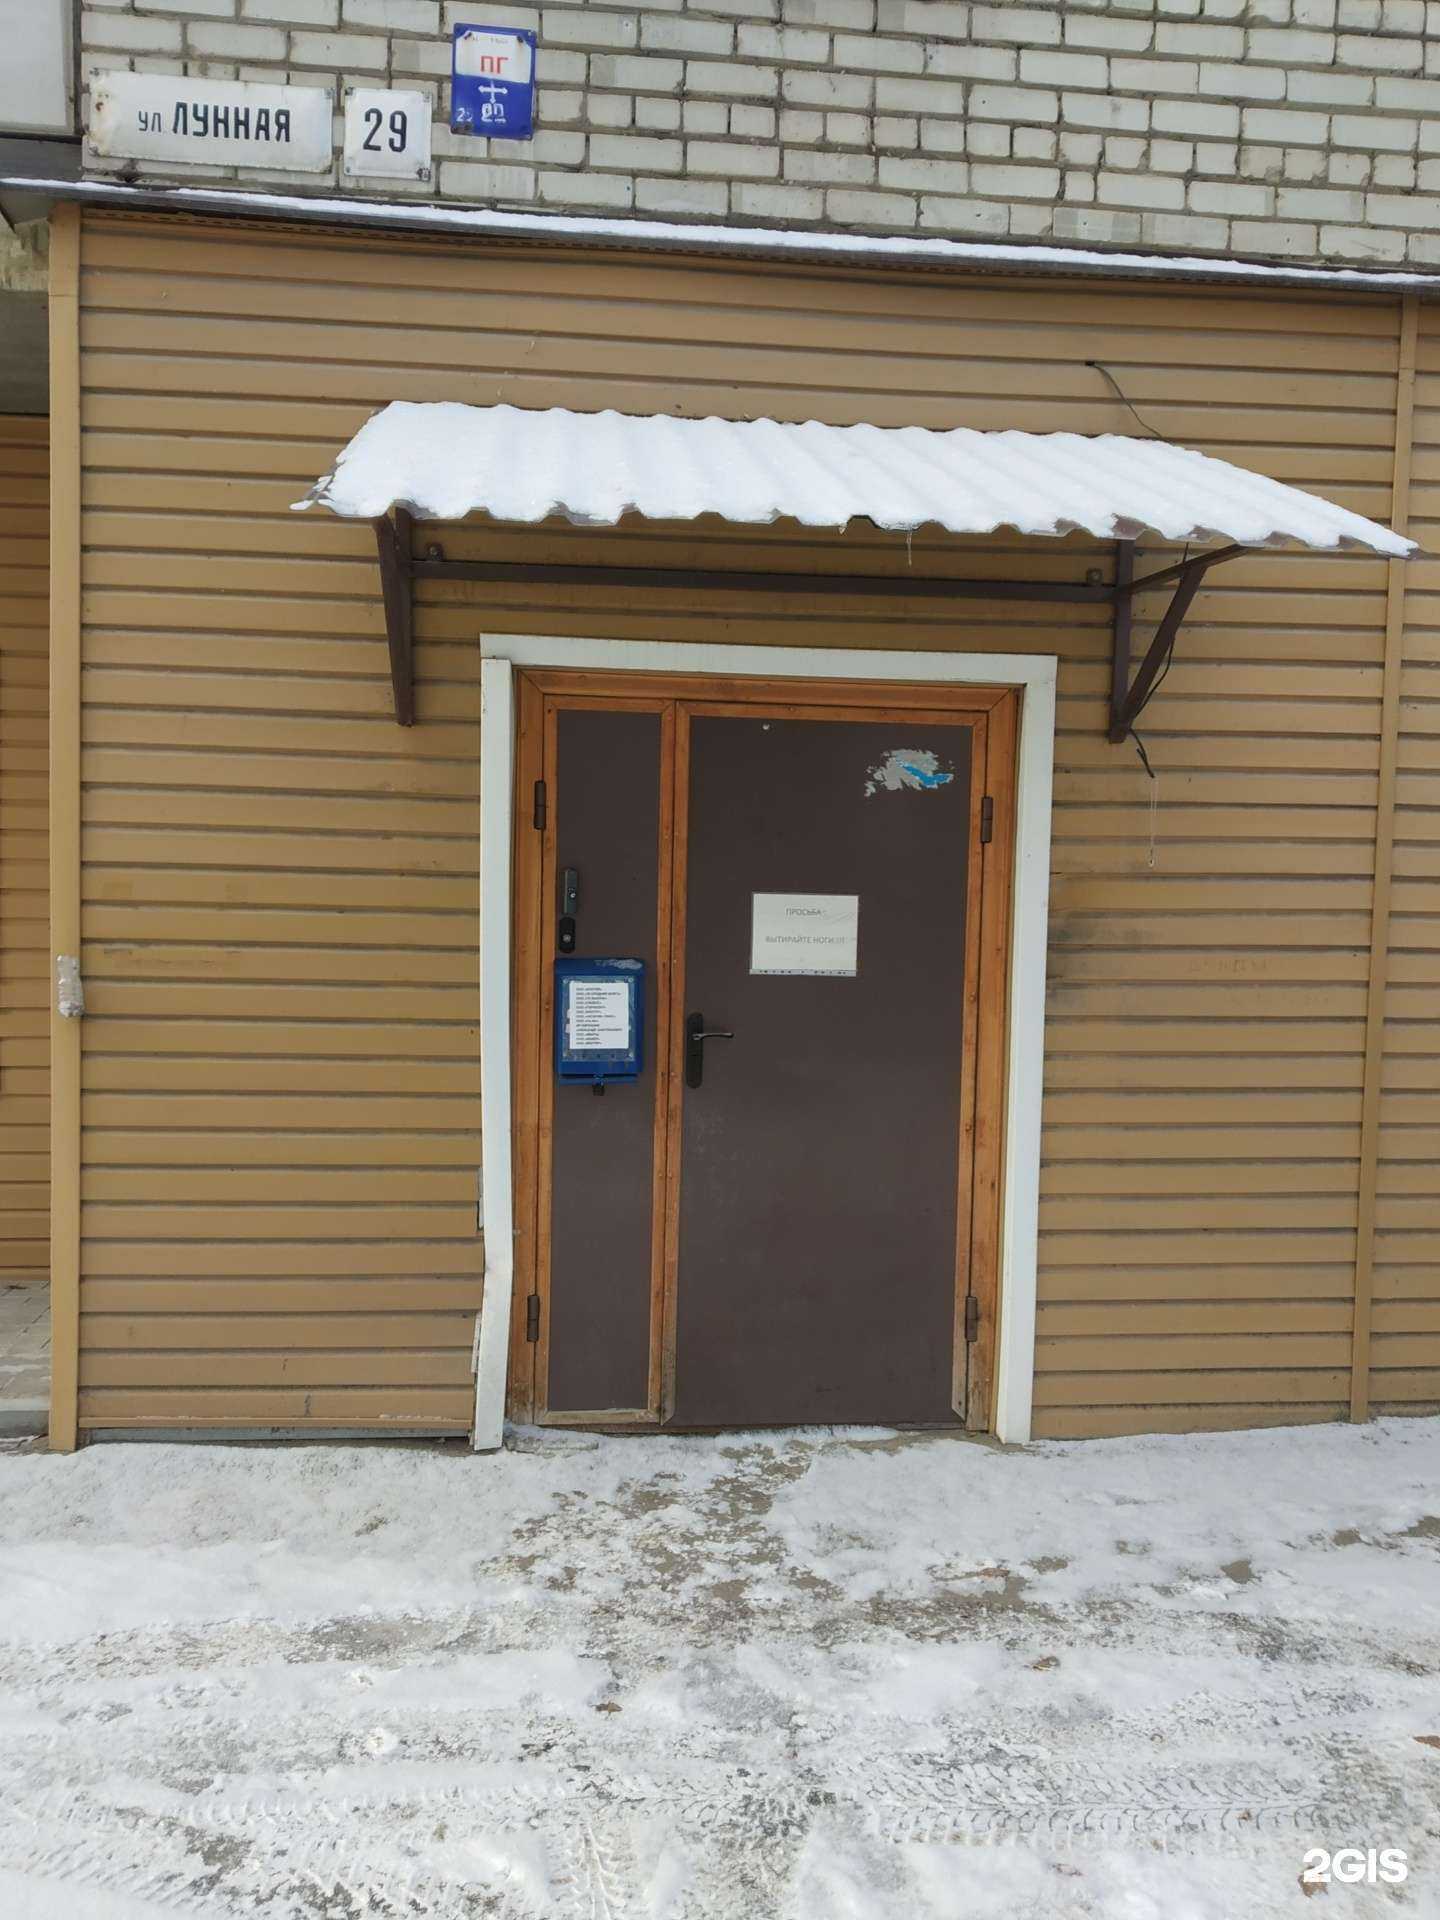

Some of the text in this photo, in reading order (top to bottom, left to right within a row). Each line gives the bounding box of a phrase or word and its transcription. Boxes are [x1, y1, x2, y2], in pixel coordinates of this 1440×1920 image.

[480, 55, 509, 75] ПГ
[172, 101, 291, 143] ЛУННАЯ
[362, 107, 408, 154] 29
